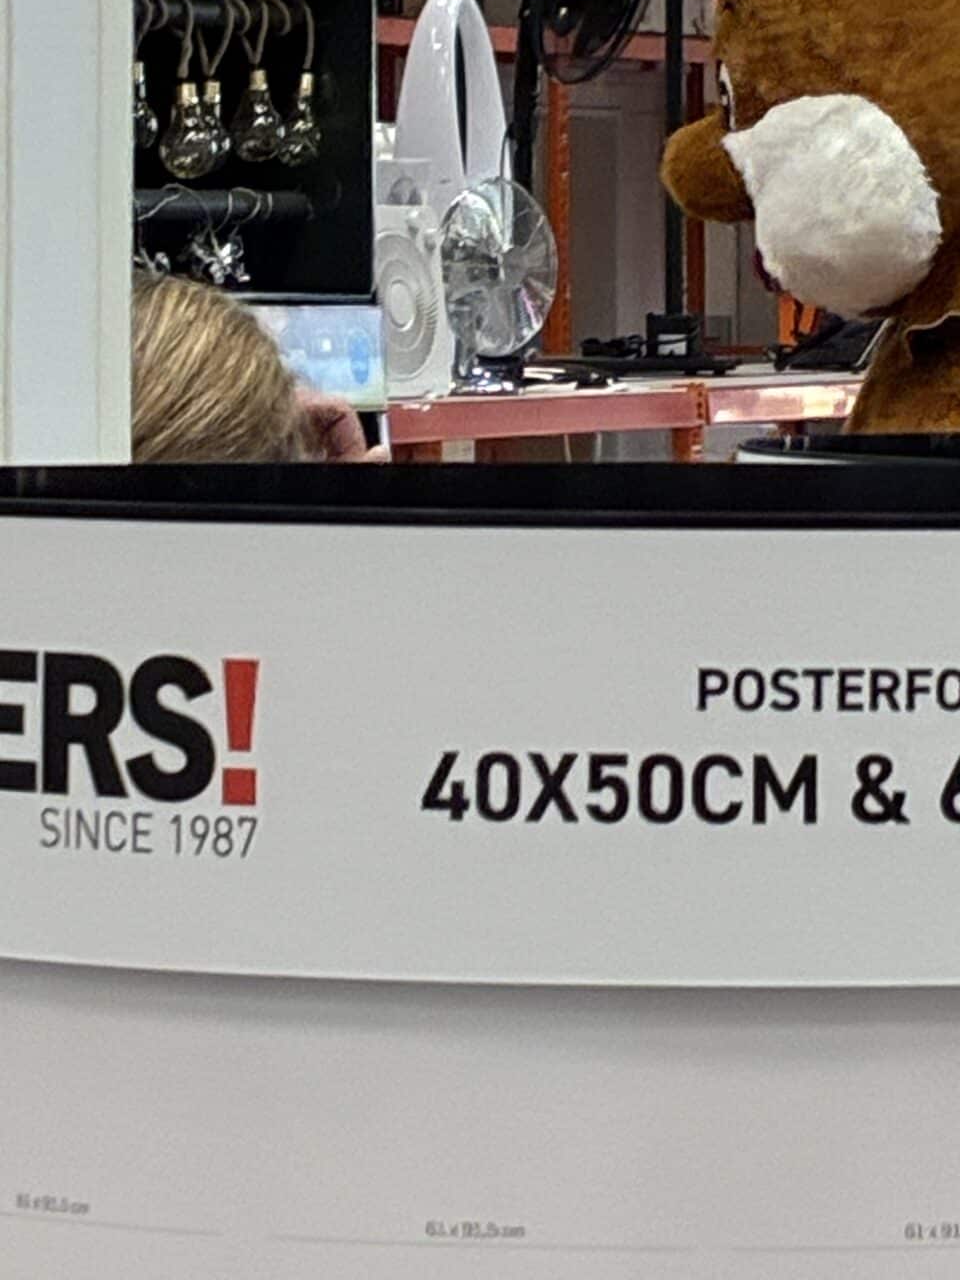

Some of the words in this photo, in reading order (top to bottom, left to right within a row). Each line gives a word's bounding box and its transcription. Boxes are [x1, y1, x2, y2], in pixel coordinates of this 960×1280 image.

[420, 750, 819, 824] 40X50CM
[850, 753, 910, 825] &
[40, 807, 153, 854] SINCE
[167, 813, 258, 858] 1987
